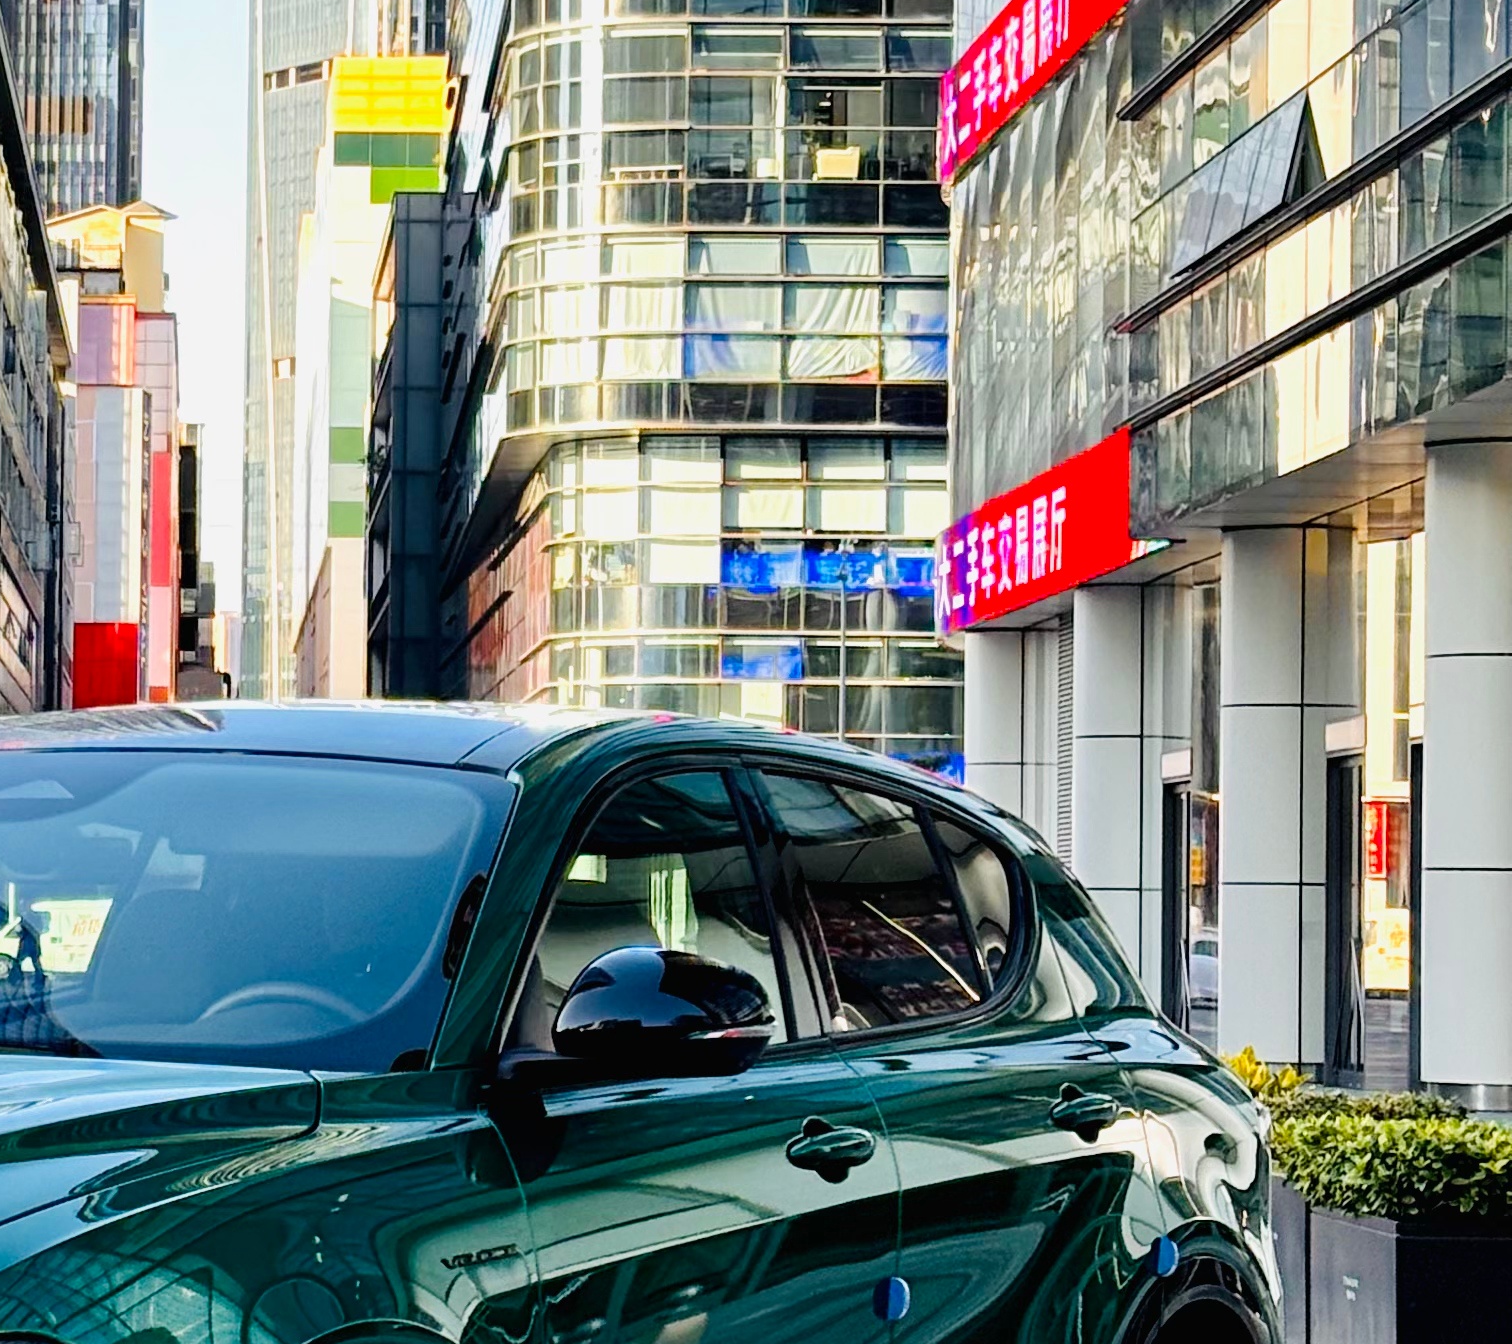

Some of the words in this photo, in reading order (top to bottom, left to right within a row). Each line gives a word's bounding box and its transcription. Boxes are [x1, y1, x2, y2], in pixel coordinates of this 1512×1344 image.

[933, 485, 1067, 619] 大二手车交易展厅
